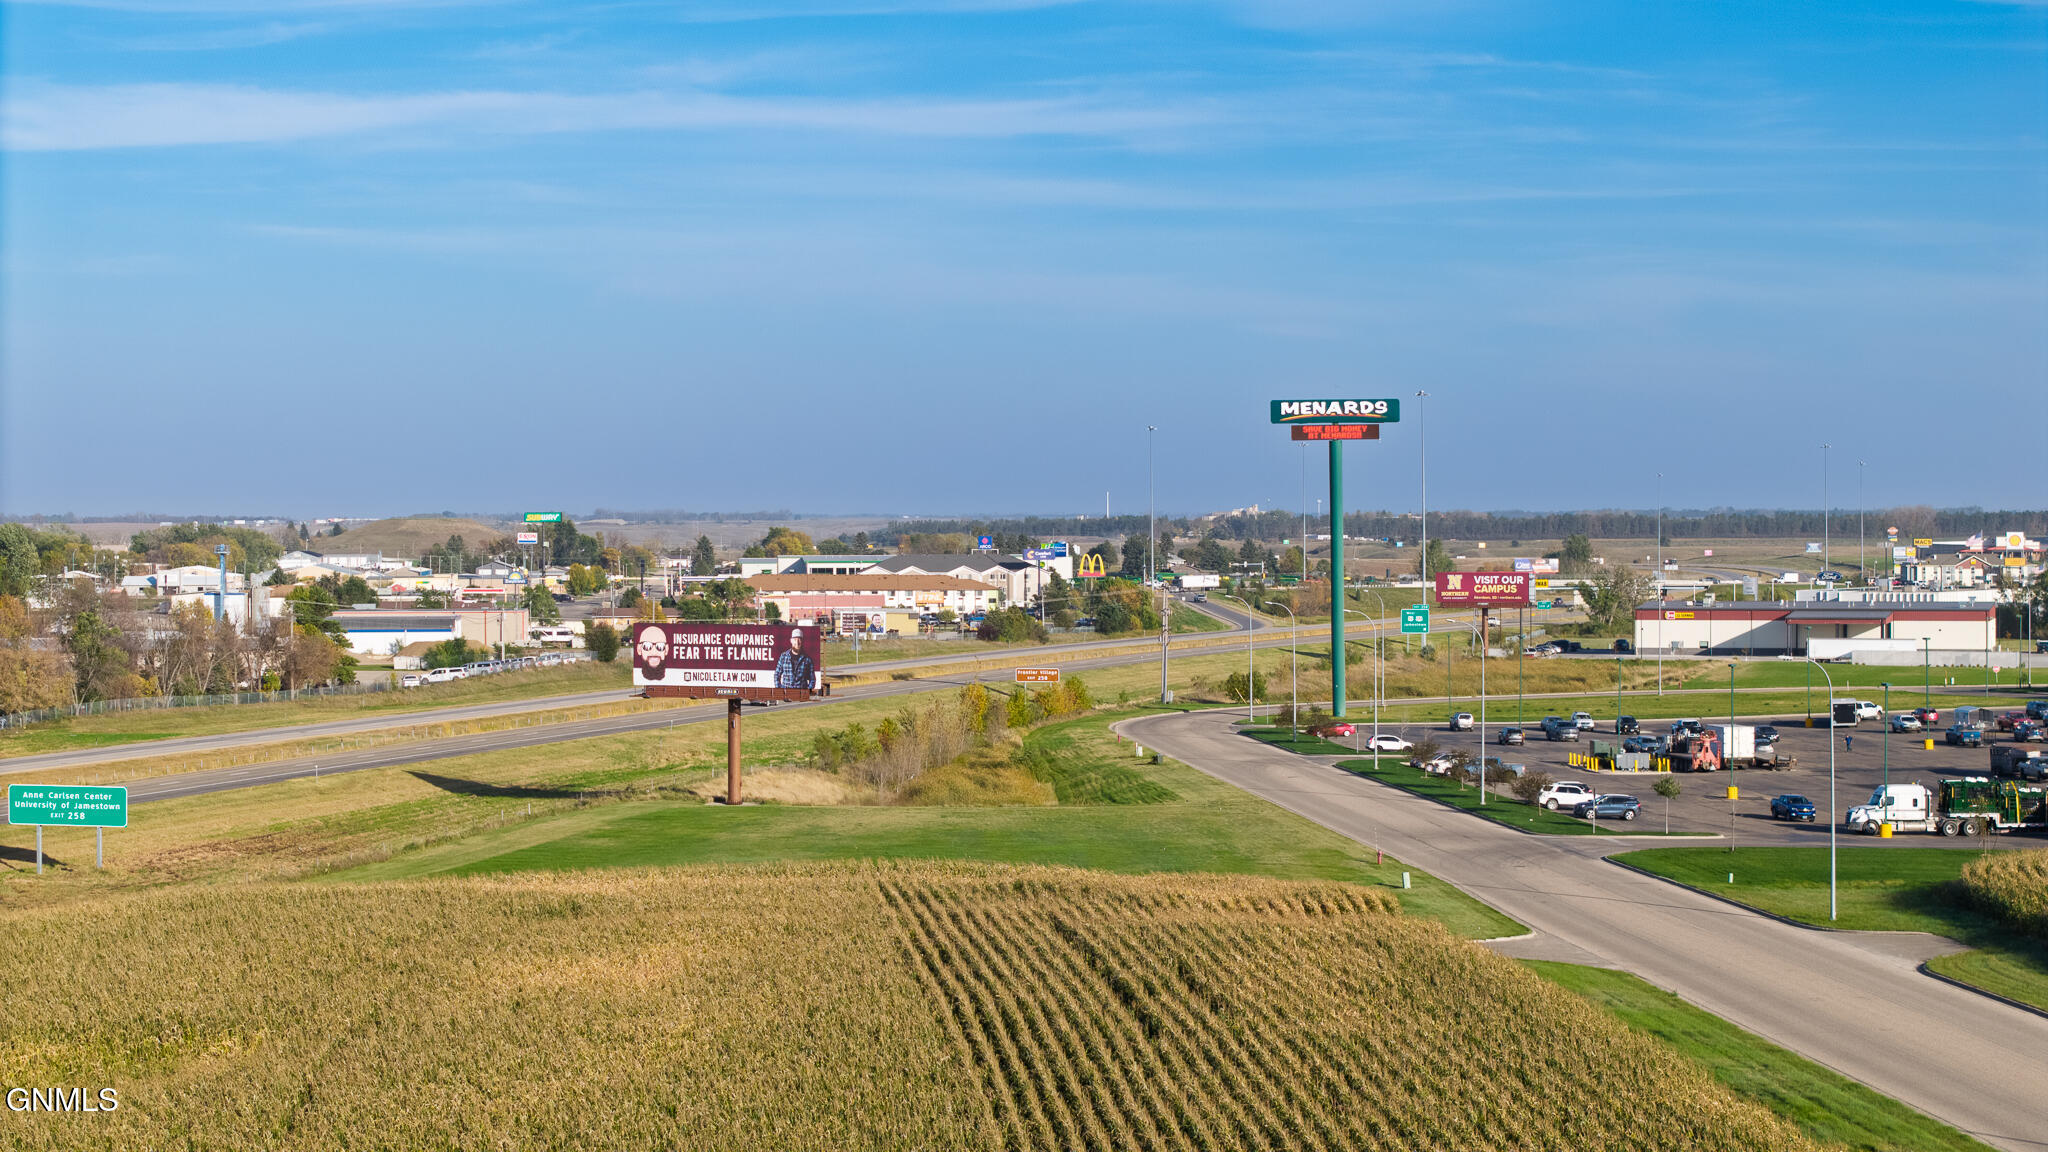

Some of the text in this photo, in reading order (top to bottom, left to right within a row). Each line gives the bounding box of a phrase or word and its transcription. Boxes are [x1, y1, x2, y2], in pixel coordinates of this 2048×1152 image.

[1281, 401, 1388, 415] MENARDS
[1302, 425, 1368, 433] SAVE BIG MONEY
[1447, 574, 1463, 589] N
[1473, 575, 1524, 584] VISIT OUR
[1473, 584, 1517, 593] CAMPUS
[673, 633, 775, 646] INSURANCE COMPANIES
[673, 646, 775, 661] FEAR THE FLANNEL
[692, 672, 757, 682] NICOLETLAW.COM
[22, 791, 113, 800] Anne Carlsen Center
[14, 801, 121, 810] University of Jamestown
[67, 811, 86, 820] 258
